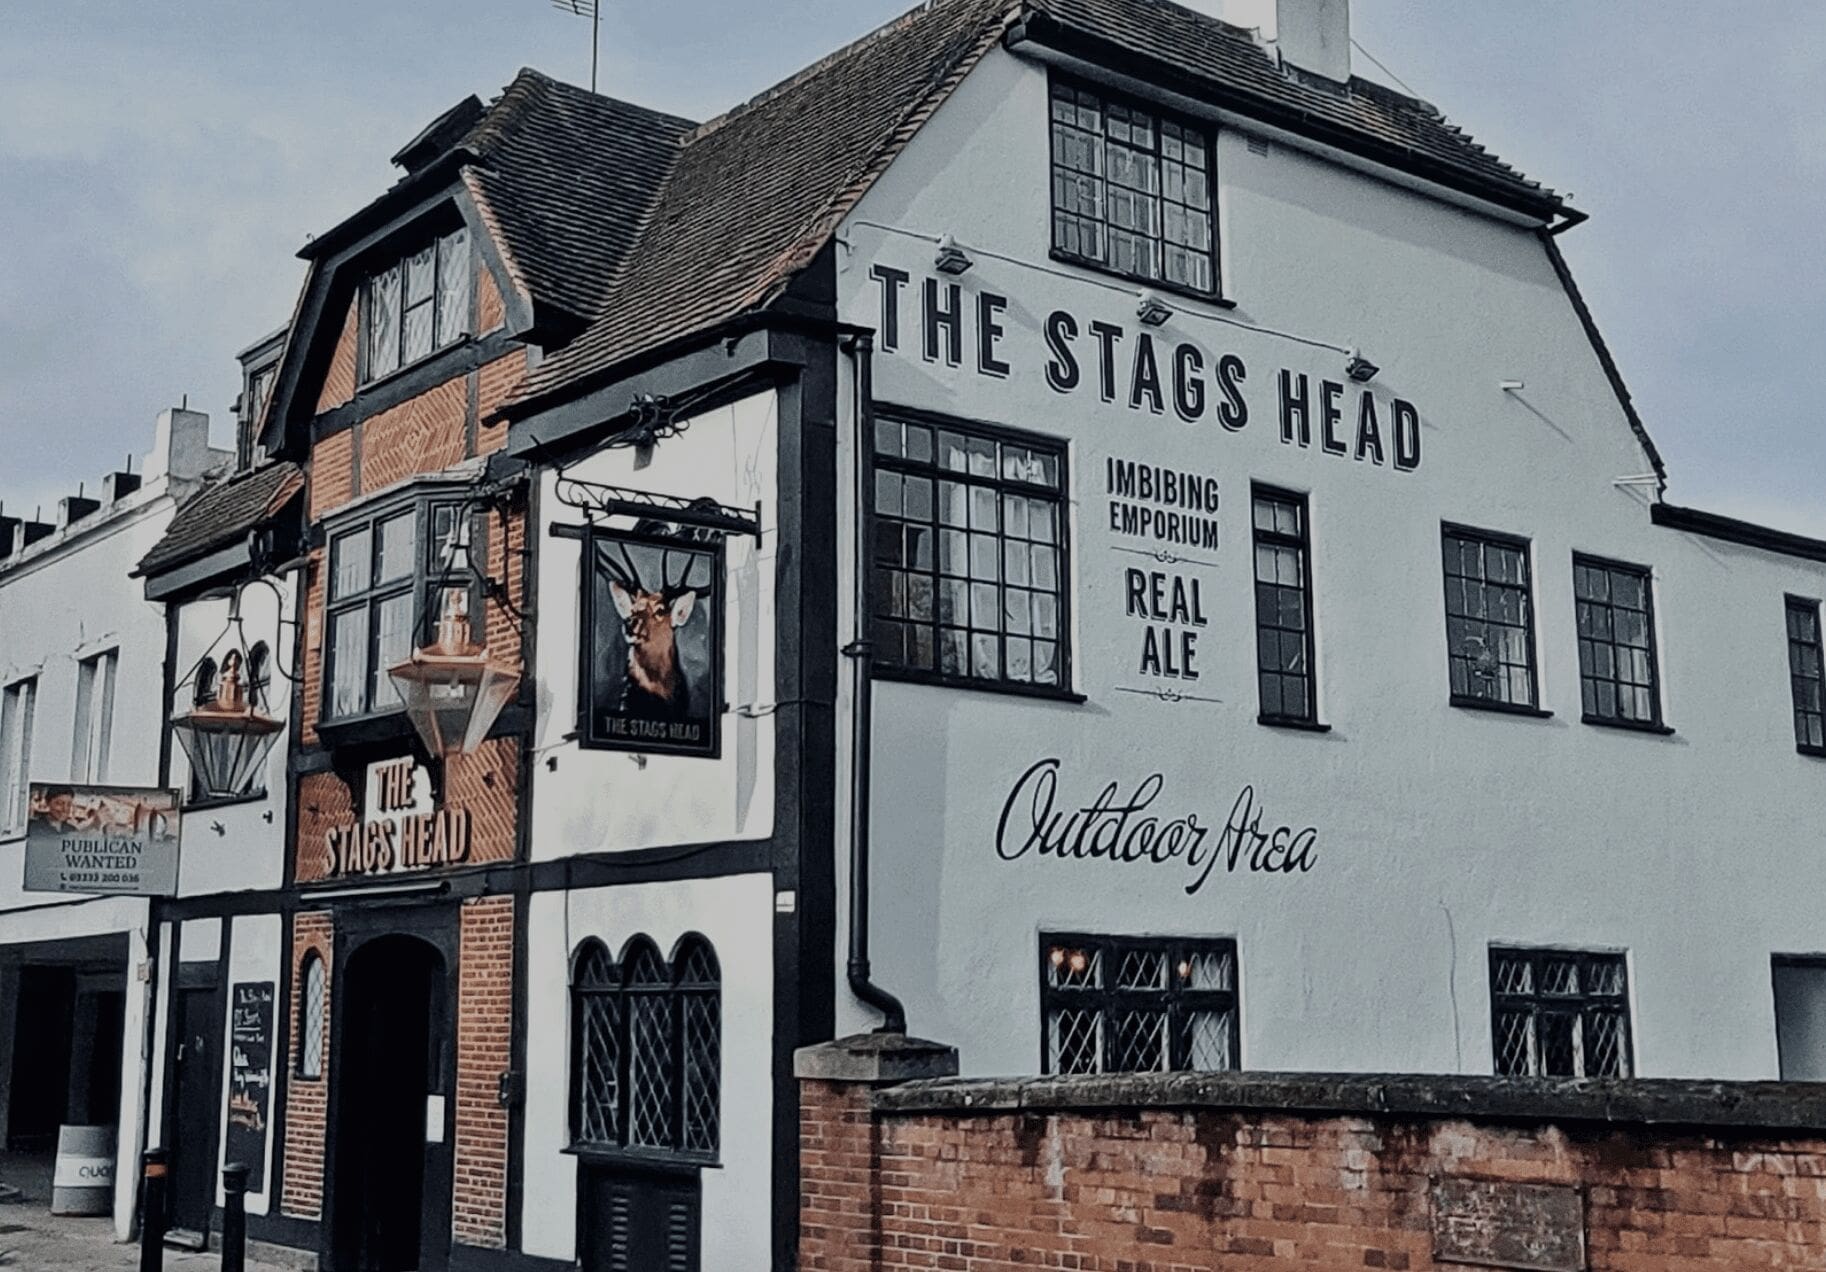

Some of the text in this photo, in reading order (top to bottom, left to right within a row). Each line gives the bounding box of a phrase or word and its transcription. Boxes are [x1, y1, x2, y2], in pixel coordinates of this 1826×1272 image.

[868, 264, 1423, 472] THE STAGS HEAD
[1106, 457, 1219, 514] IMBIBING
[1109, 501, 1219, 551] EMPORIUM
[1125, 567, 1208, 628] REAL
[1139, 625, 1200, 681] ALE
[605, 716, 700, 741] THE STAGS HEAD
[375, 761, 415, 811] THE
[61, 838, 142, 854] PUBLICAN
[325, 808, 472, 877] STAGS HEAD
[996, 758, 1318, 895] Outdoor Area
[65, 854, 137, 869] WANTED
